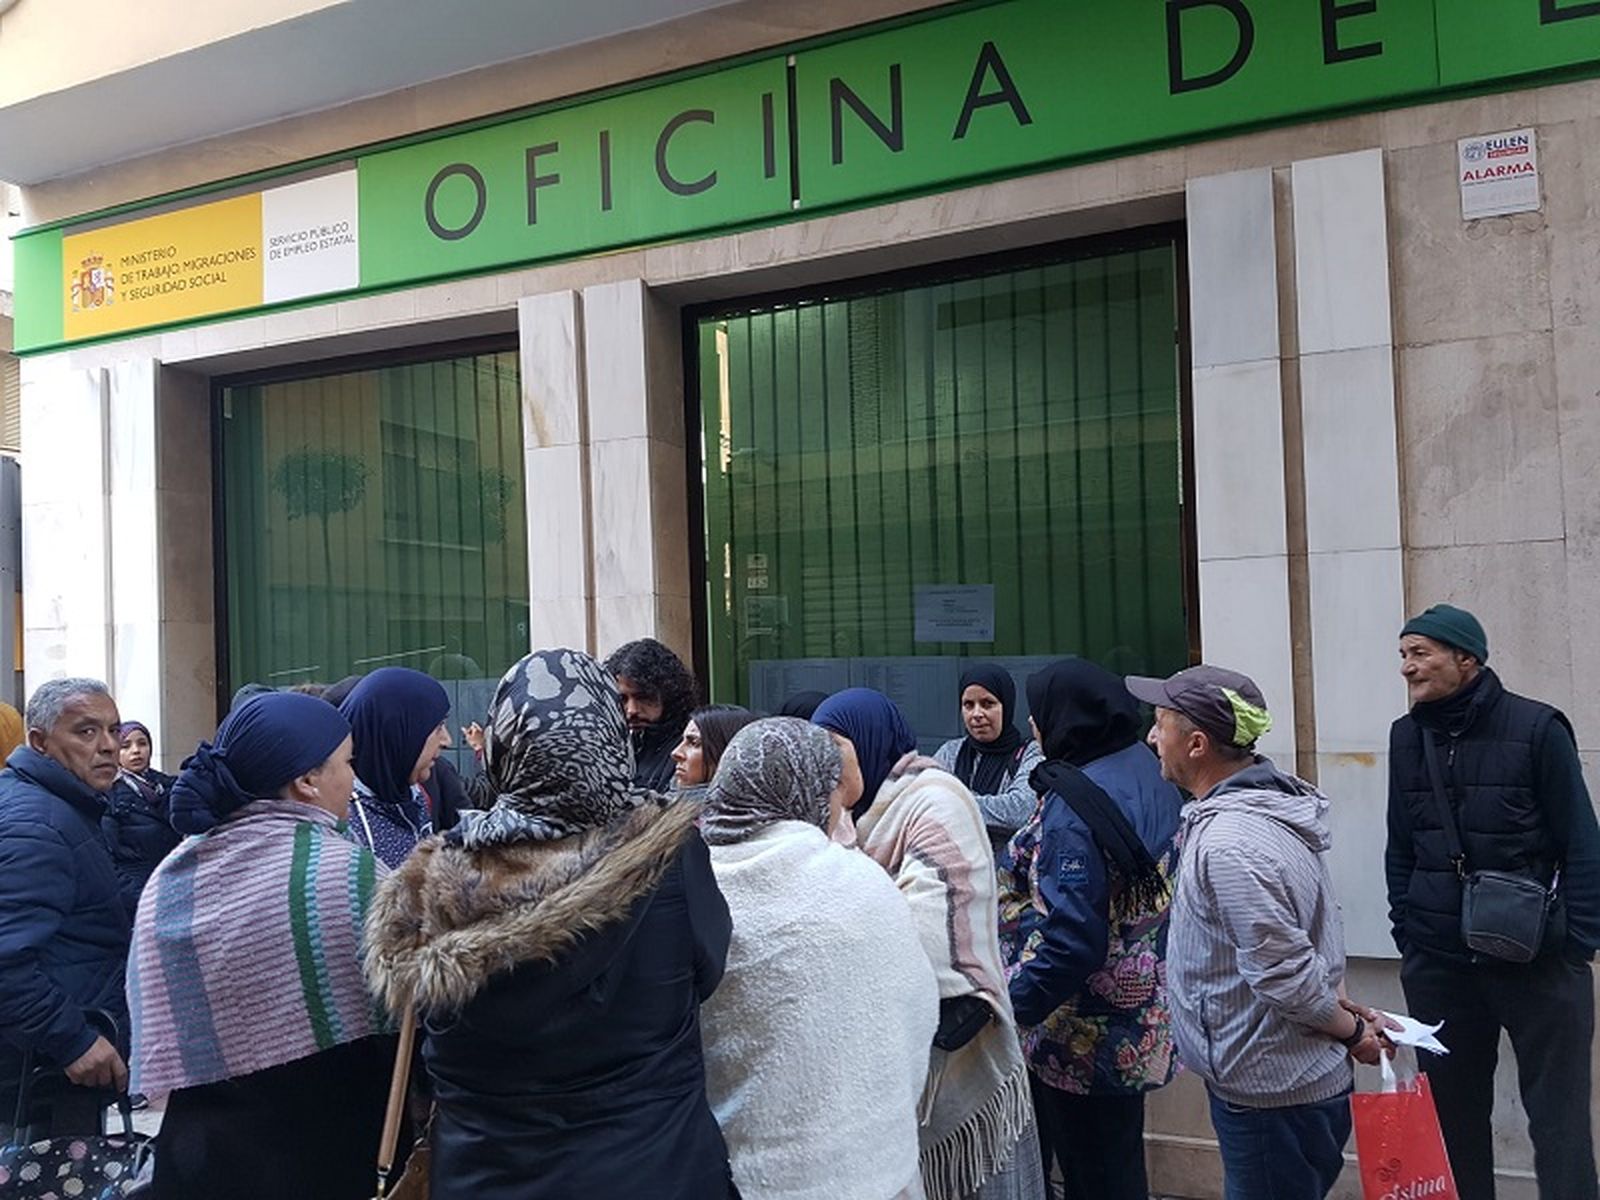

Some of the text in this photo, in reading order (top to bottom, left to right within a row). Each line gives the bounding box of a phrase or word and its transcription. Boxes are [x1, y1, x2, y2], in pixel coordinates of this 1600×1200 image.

[424, 0, 1383, 241] OFICINA DE
[1486, 135, 1529, 151] EULEN
[1463, 161, 1535, 181] ALARMA
[269, 230, 308, 248] SERVICIO
[269, 234, 356, 260] DE EMPLEO ESTATAL
[120, 245, 177, 268] MINISTERIO
[121, 271, 134, 285] DE
[183, 247, 257, 271] MIGRACIONES
[120, 271, 228, 301] Y SEGURIDAD SOCIAL
